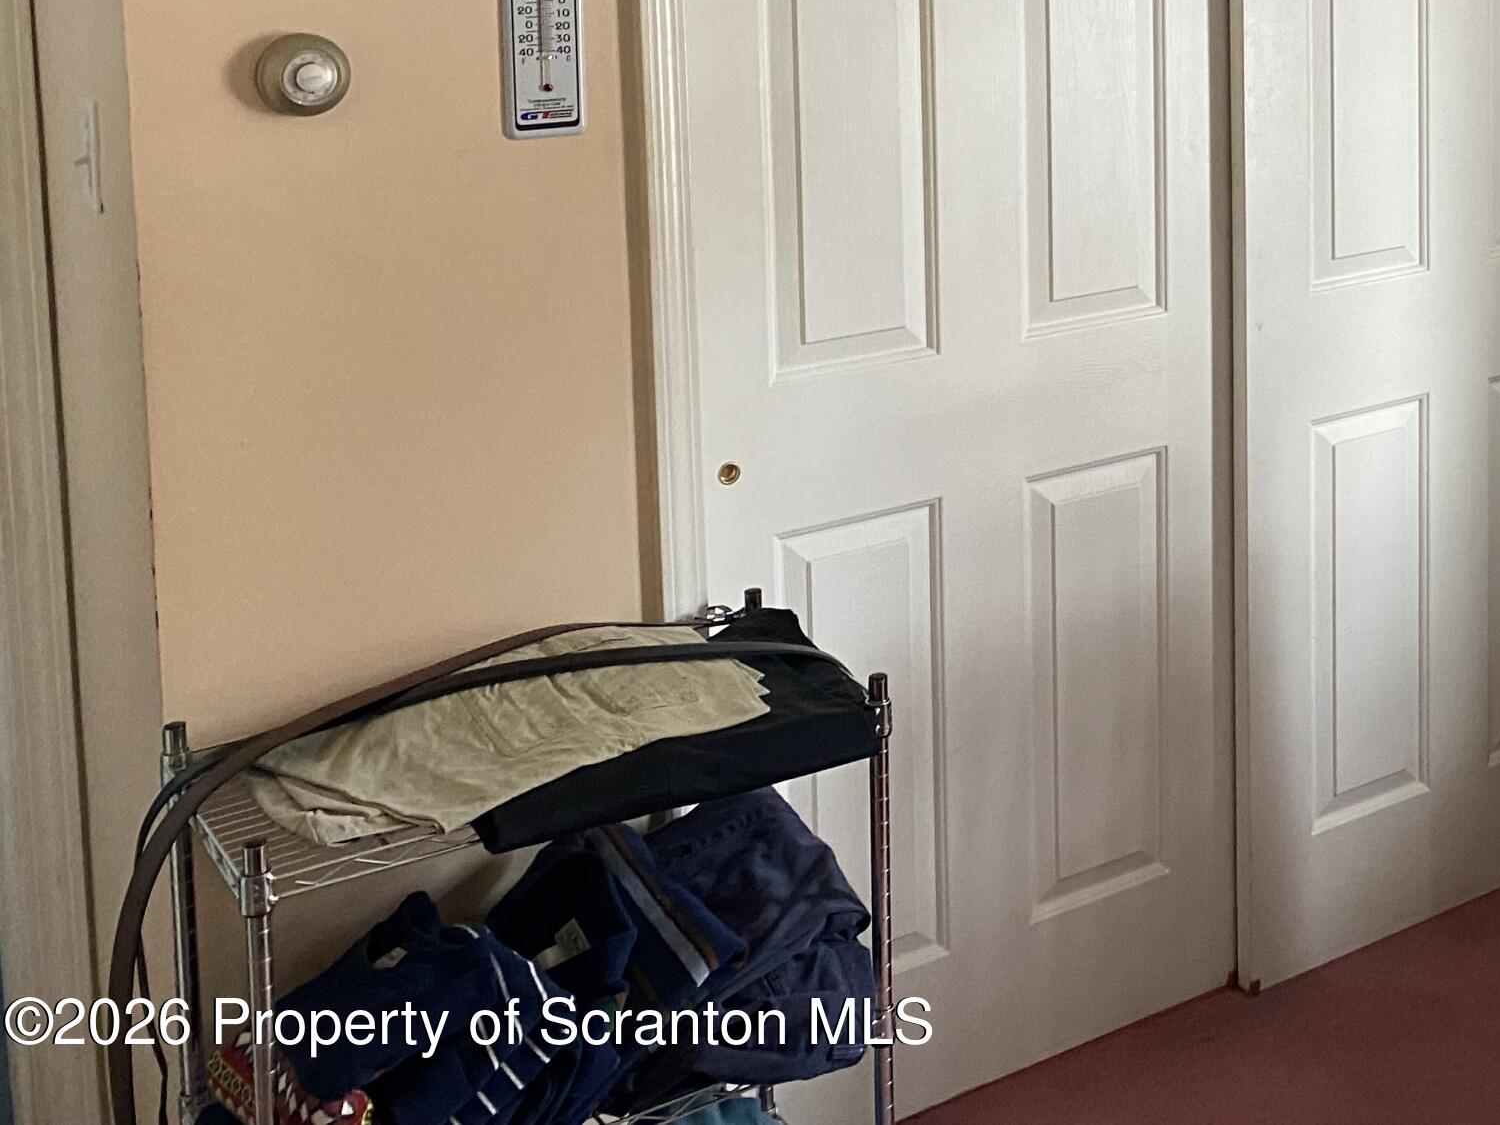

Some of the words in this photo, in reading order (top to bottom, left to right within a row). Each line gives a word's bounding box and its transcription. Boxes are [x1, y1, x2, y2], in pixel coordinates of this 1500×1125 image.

[517, 6, 533, 15] 20
[556, 9, 570, 17] 10
[525, 20, 533, 29] 0
[555, 21, 570, 30] 20
[518, 34, 534, 43] 20
[556, 34, 571, 42] 30
[519, 47, 534, 57] 40
[556, 45, 571, 54] 40
